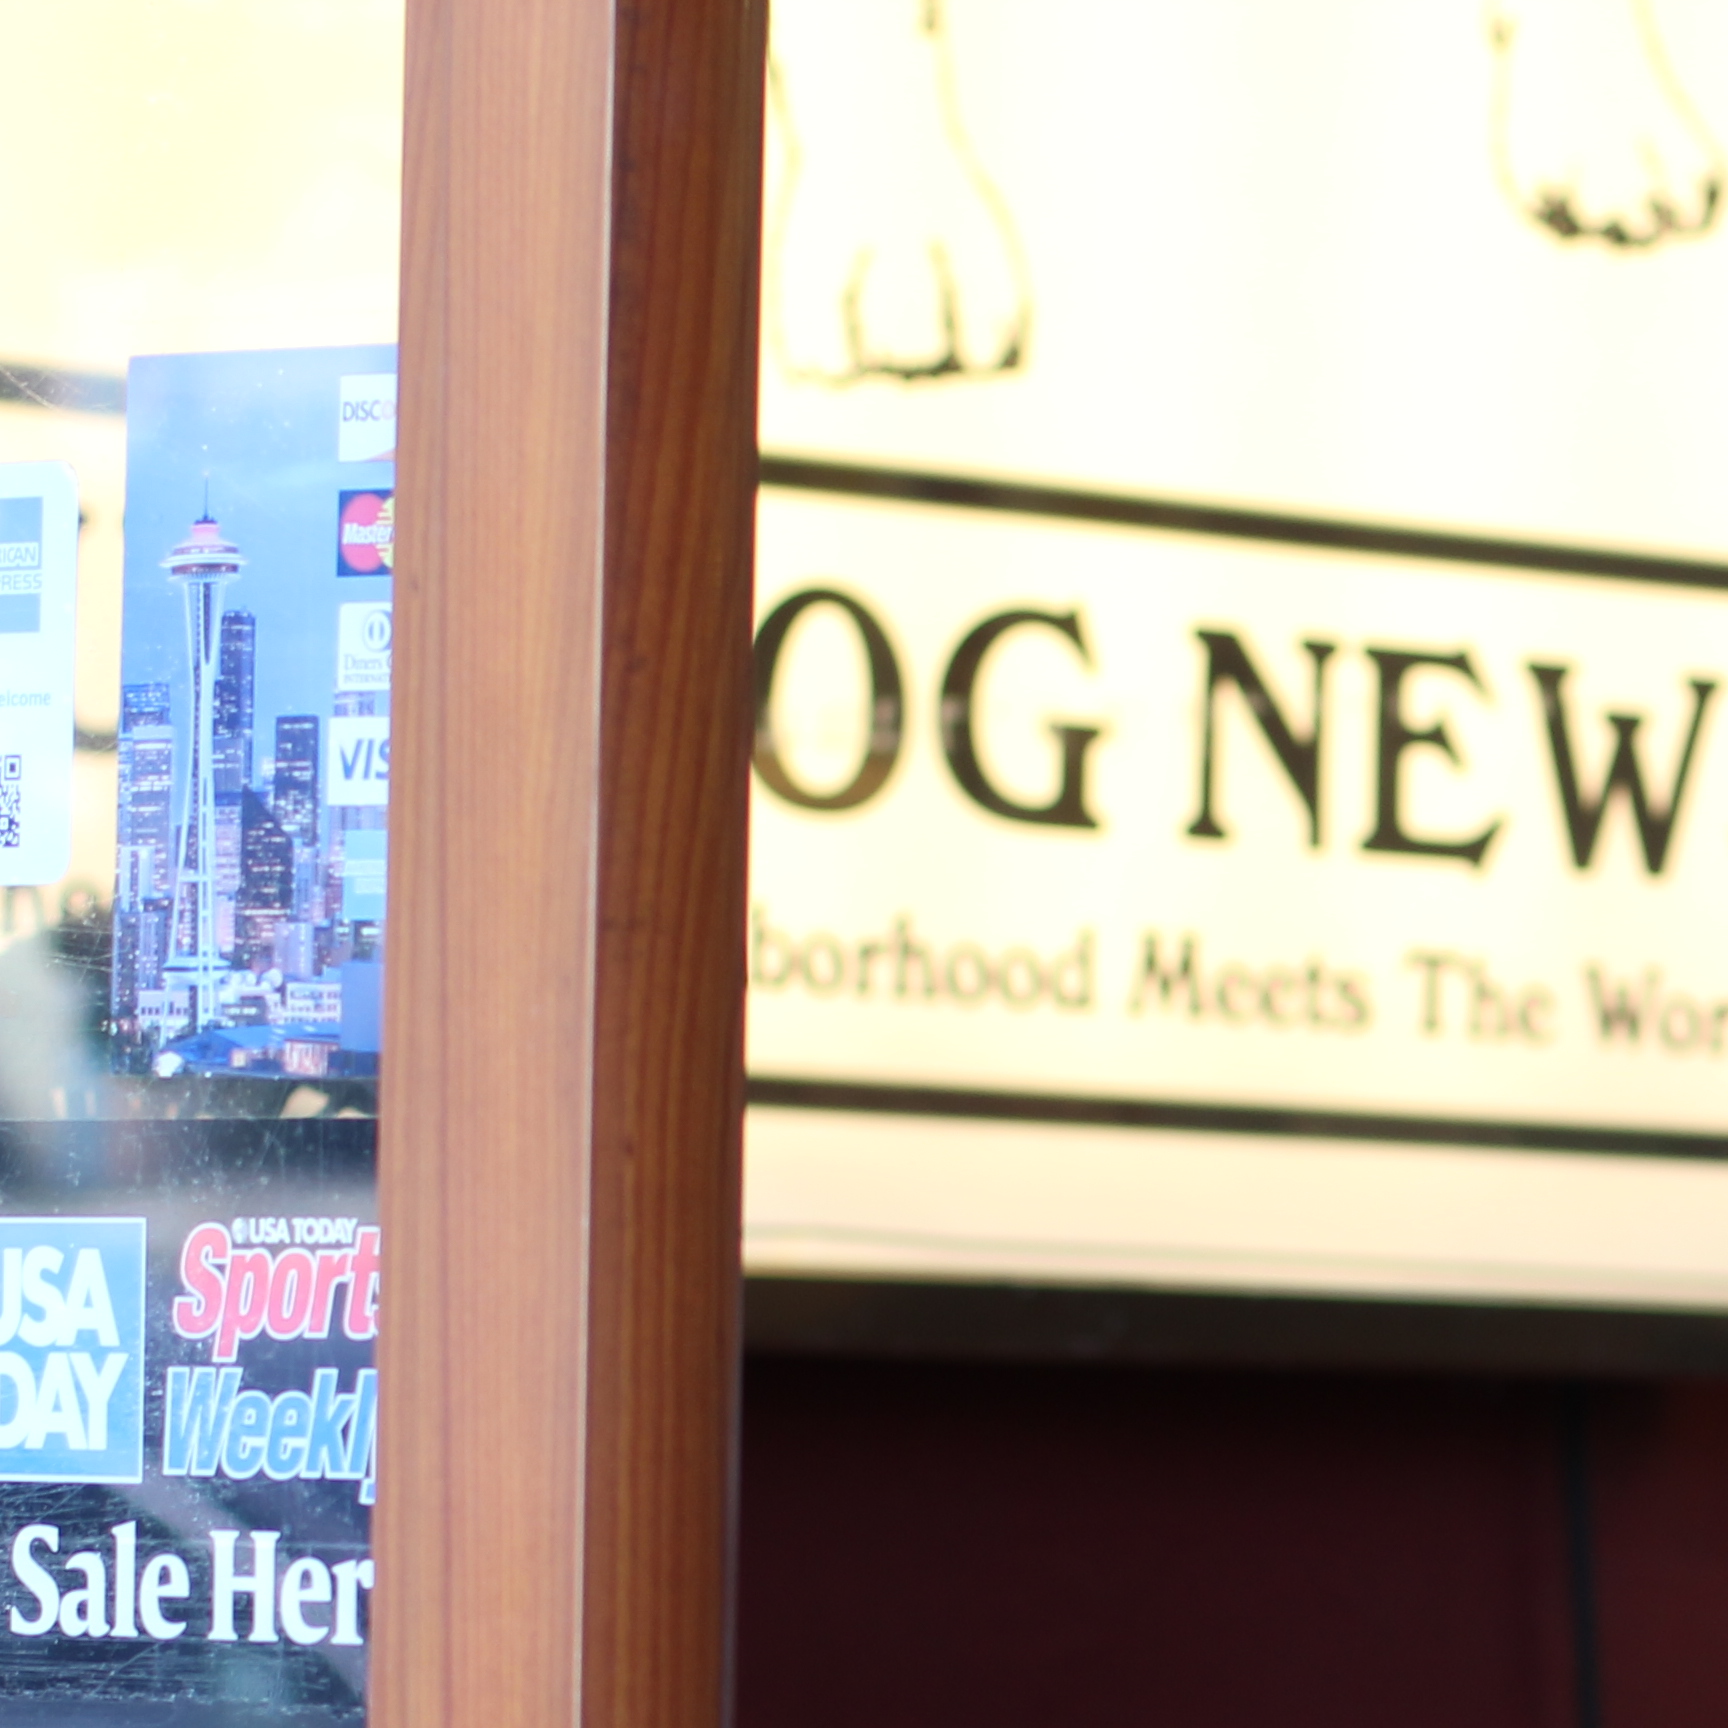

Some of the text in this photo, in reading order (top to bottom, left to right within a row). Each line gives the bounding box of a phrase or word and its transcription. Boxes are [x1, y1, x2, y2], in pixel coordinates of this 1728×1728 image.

[1128, 928, 1370, 1032] Meets
[1405, 947, 1555, 1044] The
[249, 1217, 359, 1245] USA TODAY
[173, 1221, 380, 1363] Sport
[163, 1366, 377, 1504] Weekl
[9, 1520, 191, 1639] Sale
